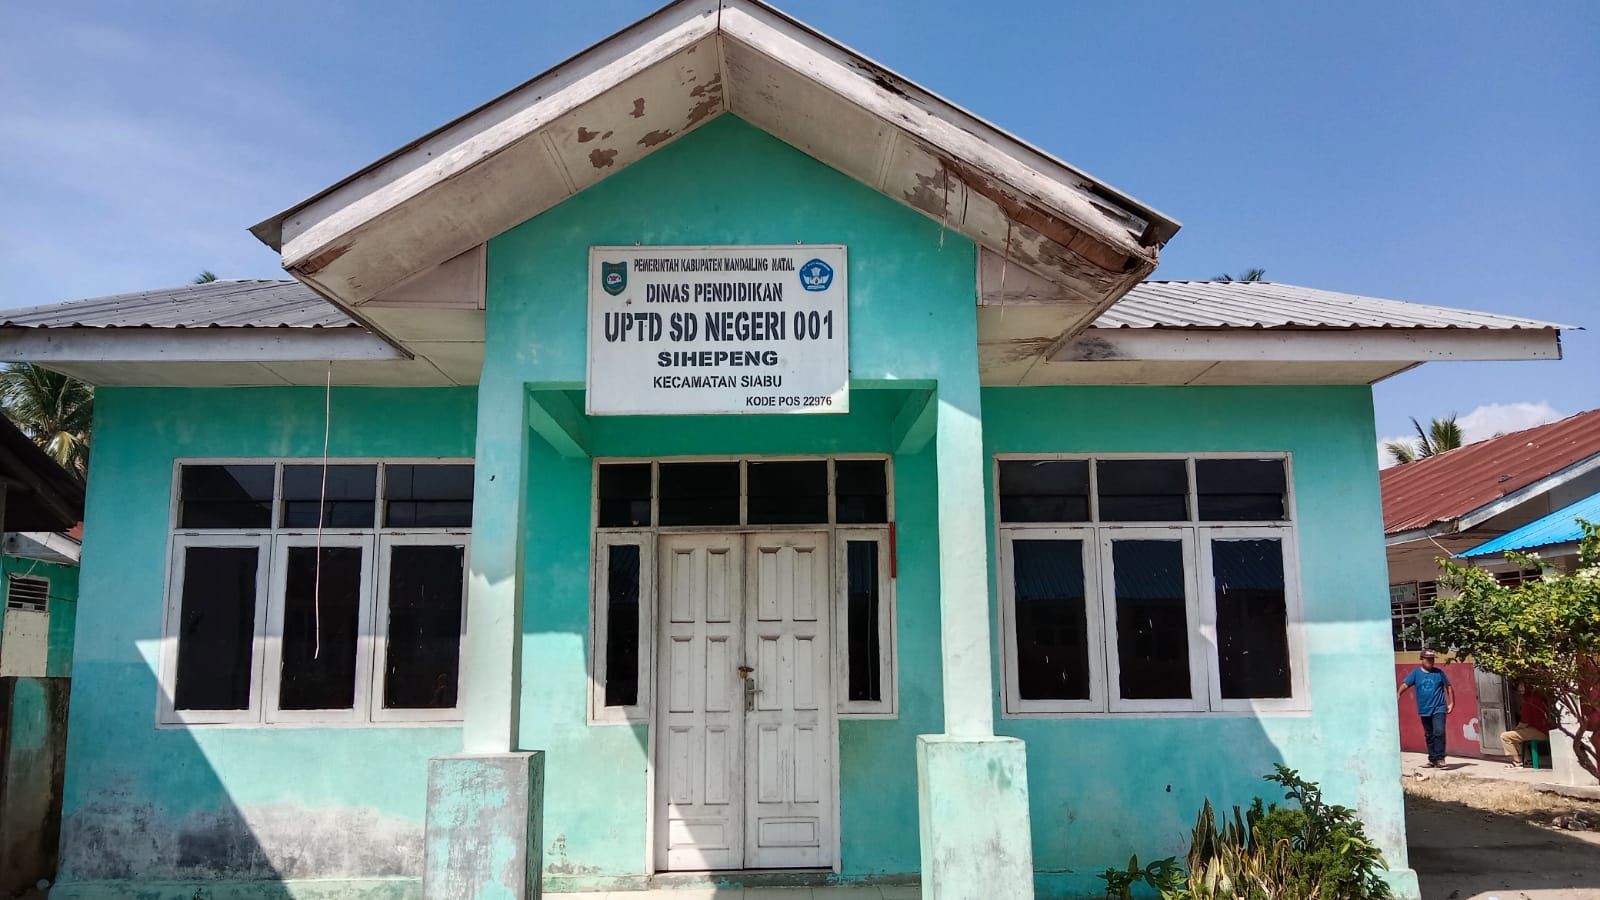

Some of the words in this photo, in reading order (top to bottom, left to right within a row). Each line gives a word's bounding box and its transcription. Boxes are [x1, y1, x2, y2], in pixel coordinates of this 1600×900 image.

[633, 258, 679, 272] PEMERINTAH
[681, 258, 722, 272] KABUPATEN
[724, 257, 768, 272] MANDAILING
[646, 283, 690, 303] DINAS
[695, 282, 783, 302] PENDIDIKAN
[605, 311, 663, 342] UPTD
[669, 311, 698, 342] SD
[705, 311, 786, 342] NEGERI
[793, 310, 833, 341] 001
[657, 351, 778, 367] SIHEPENG
[653, 375, 737, 389] KECAMATAN
[741, 375, 782, 388] SIABU
[746, 396, 776, 407] KODE
[778, 396, 800, 406] POS
[803, 396, 832, 406] 22976
